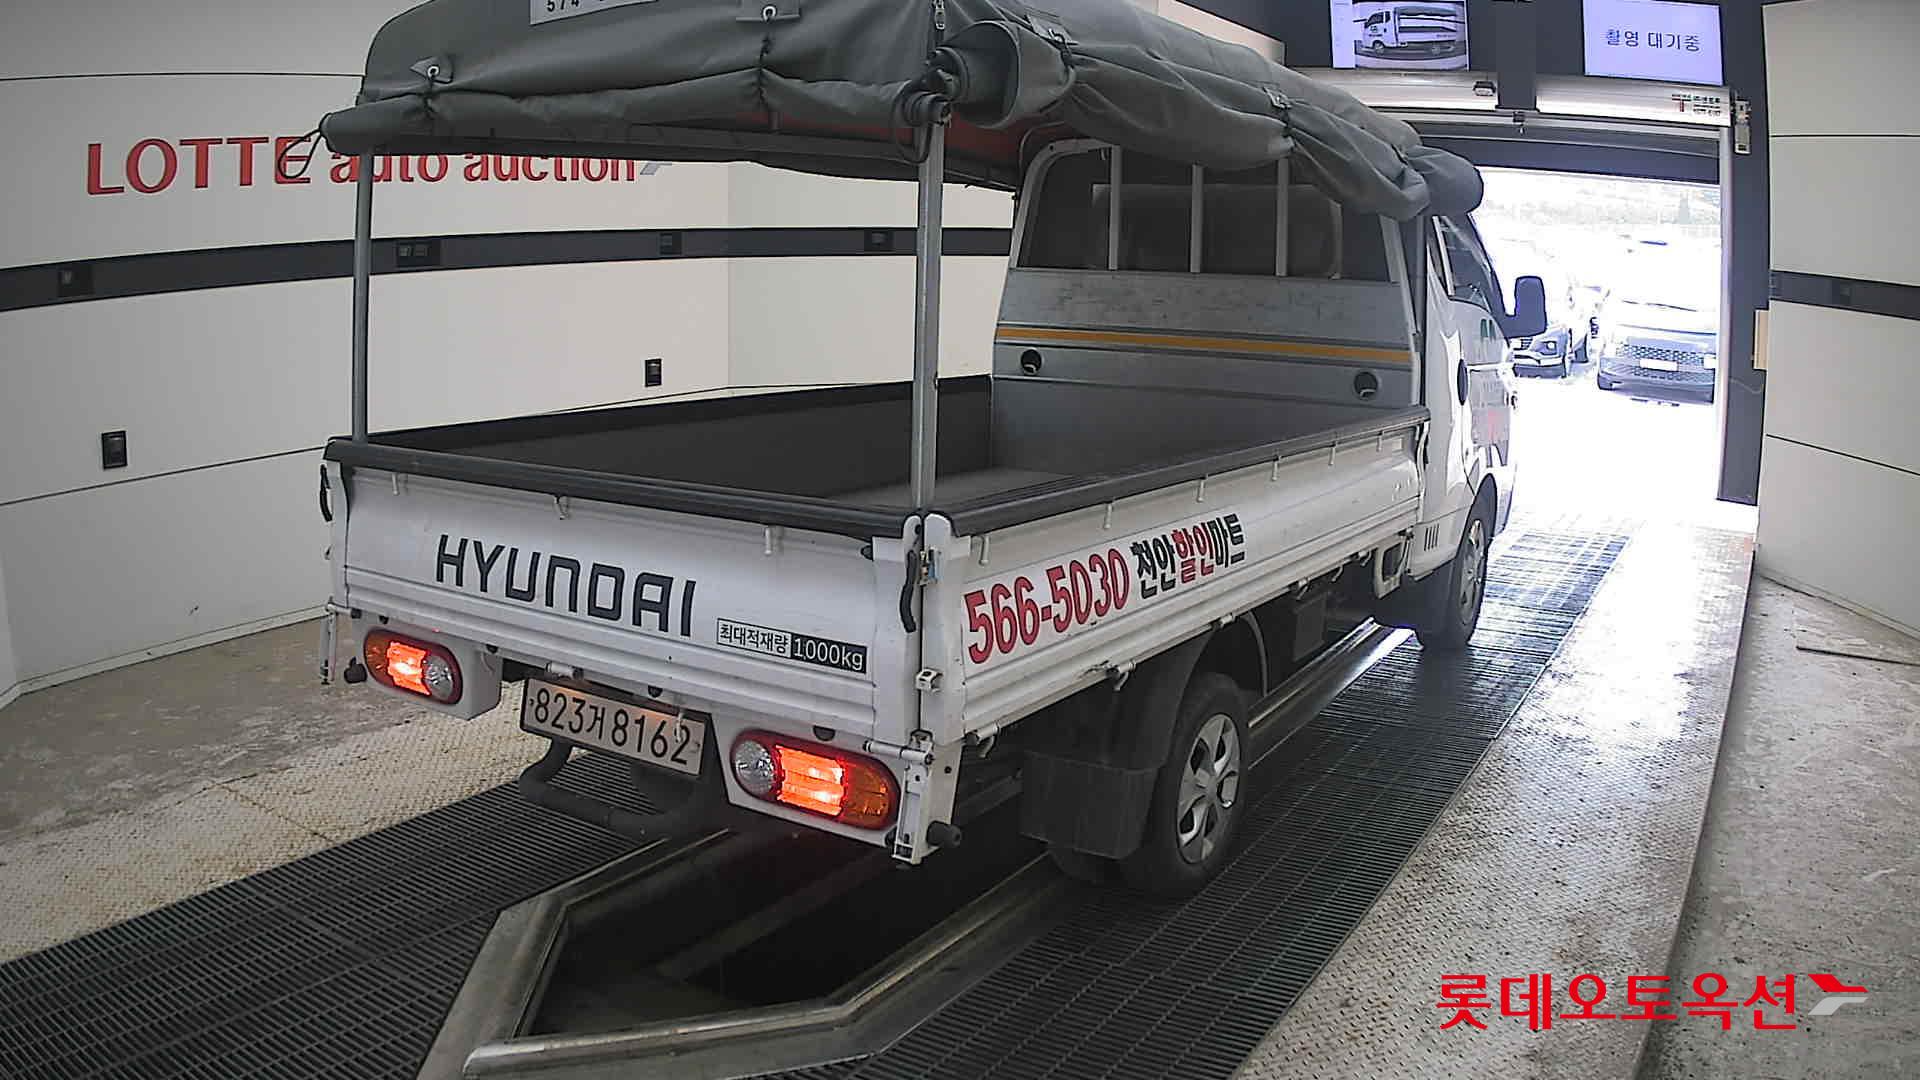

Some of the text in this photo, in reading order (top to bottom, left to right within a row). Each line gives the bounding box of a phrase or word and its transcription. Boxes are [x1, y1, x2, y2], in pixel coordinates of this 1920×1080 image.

[1648, 32, 1700, 52] 대기중
[87, 136, 635, 195] LOTTE auto auction
[436, 534, 696, 637] HYUNDAI
[964, 548, 1130, 664] 566-5030
[719, 624, 788, 654] 최대적재량
